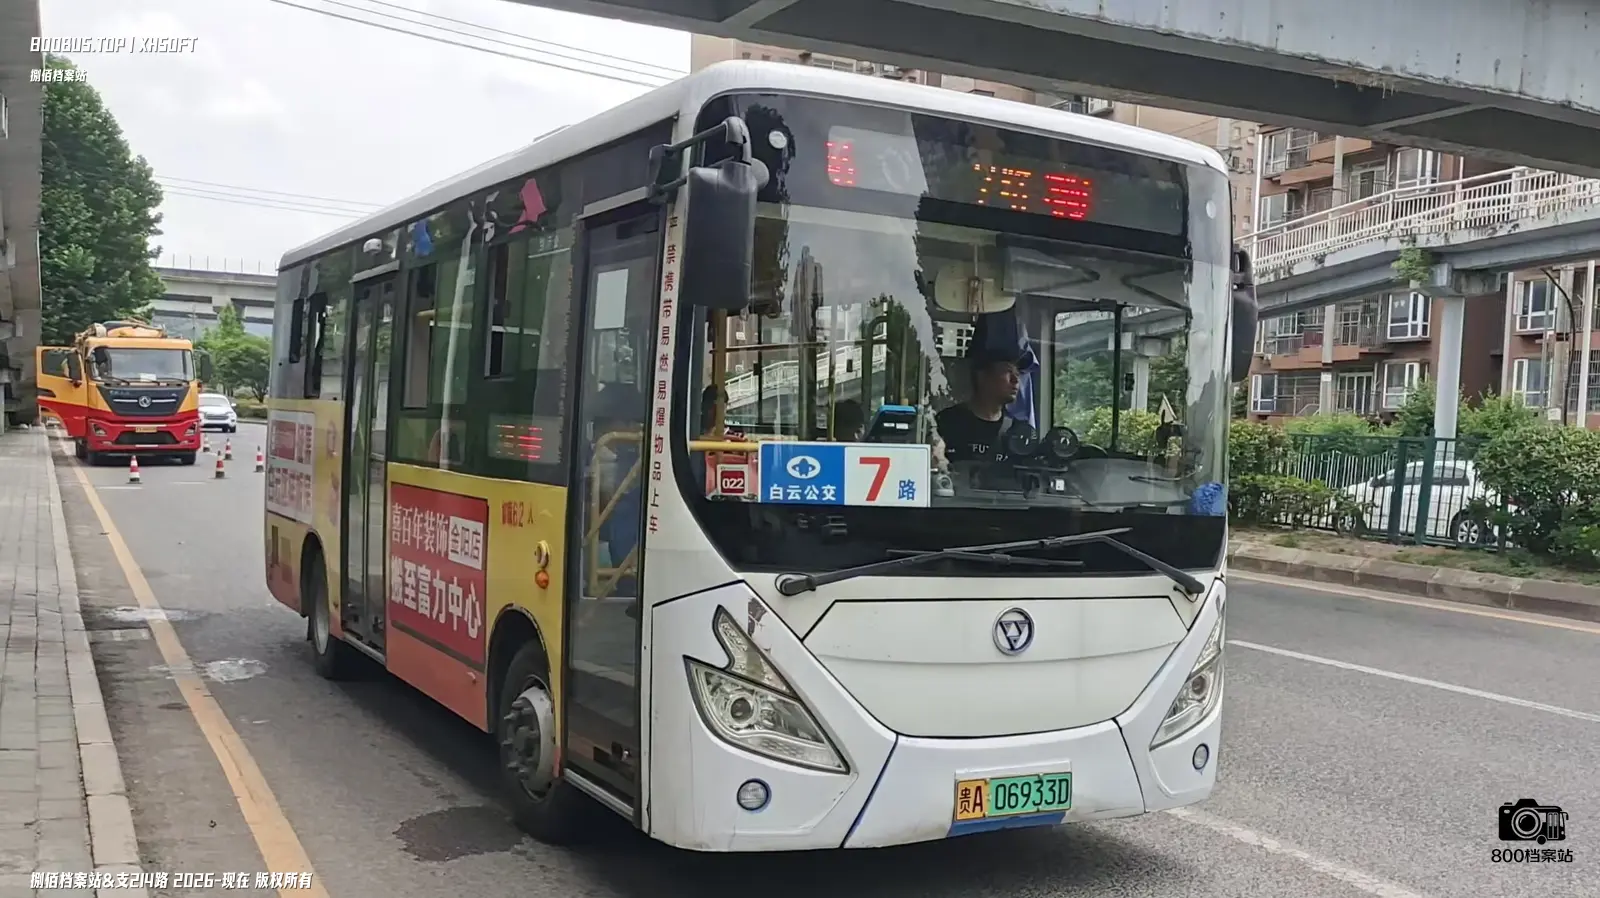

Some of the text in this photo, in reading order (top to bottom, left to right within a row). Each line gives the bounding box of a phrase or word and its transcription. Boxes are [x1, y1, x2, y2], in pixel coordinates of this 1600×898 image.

[722, 478, 744, 489] 022
[769, 483, 837, 500] 白云公交
[859, 456, 917, 502] 7 路
[391, 502, 481, 562] 喜百年装饰 金阳店
[391, 555, 482, 639] 搬至富力中心
[959, 778, 1070, 815] 贵A 06933D
